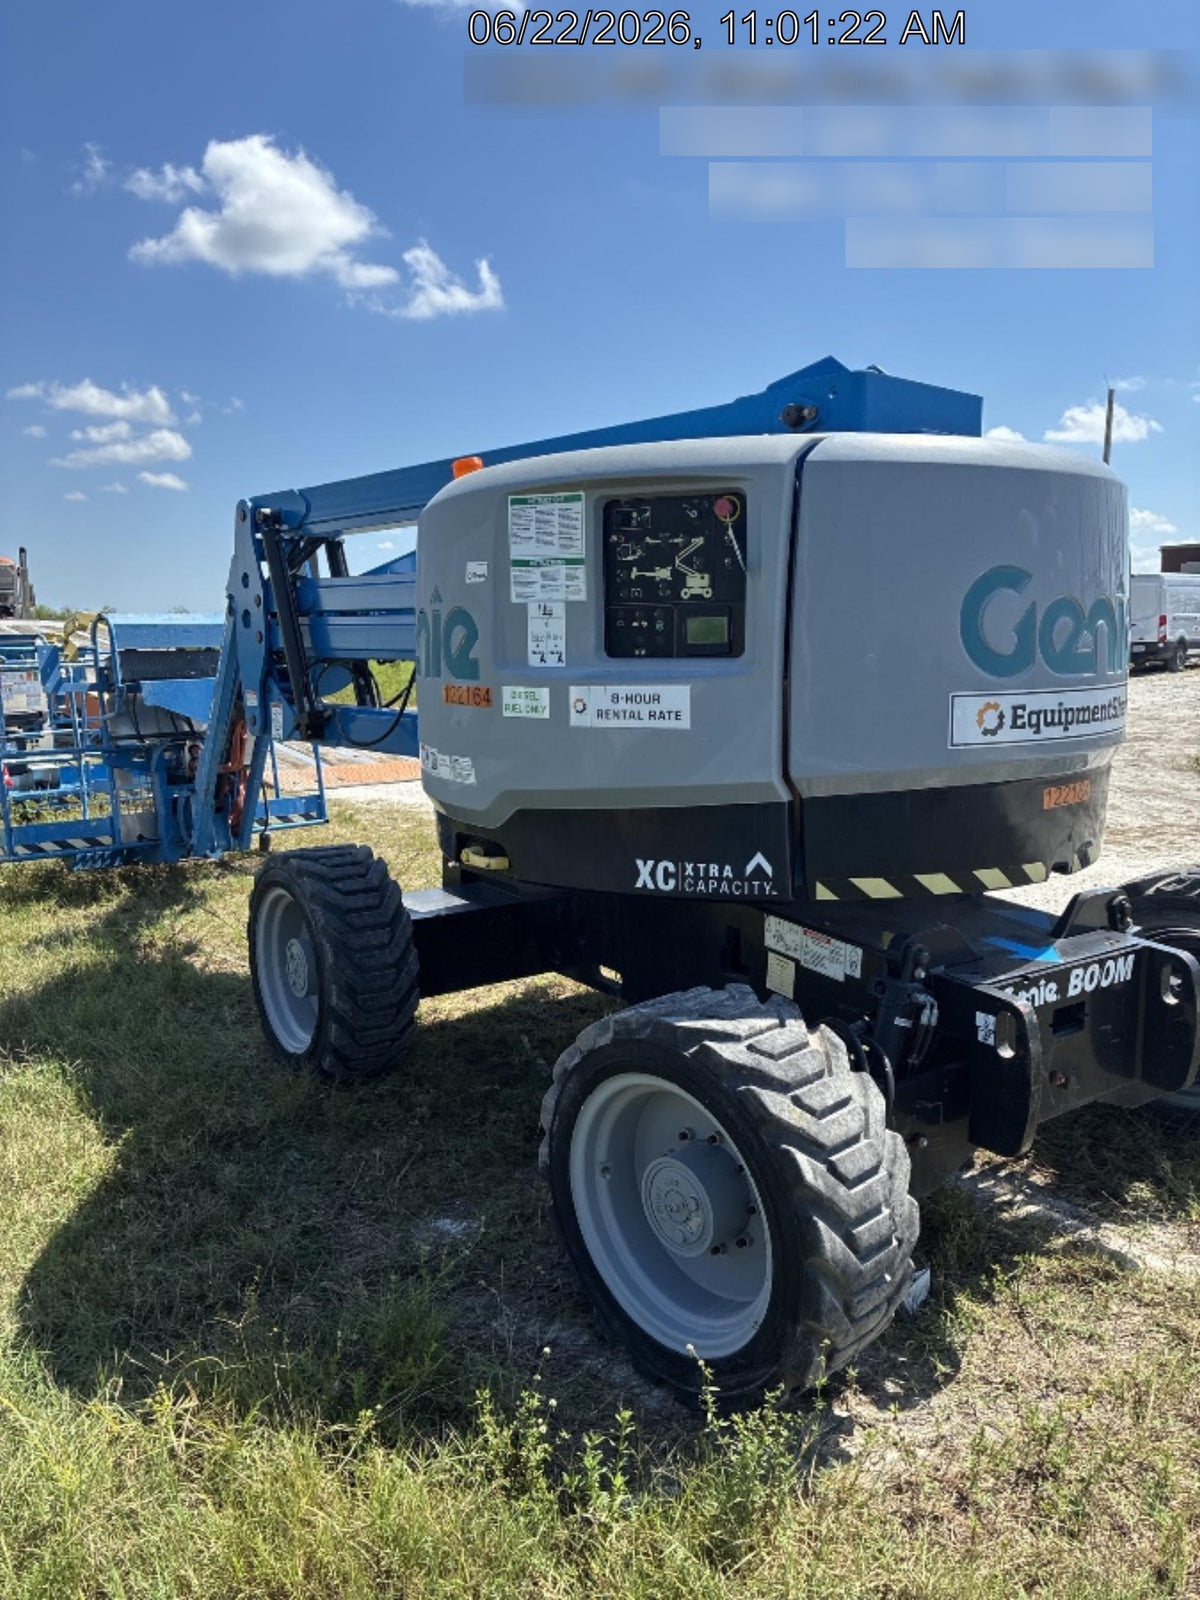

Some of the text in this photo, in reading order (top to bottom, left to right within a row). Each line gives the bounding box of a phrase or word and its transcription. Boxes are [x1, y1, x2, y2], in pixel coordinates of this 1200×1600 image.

[960, 564, 1128, 679] Geni
[444, 685, 492, 708] 122164
[610, 693, 661, 705] 8-HOUR
[525, 704, 547, 715] ONLY
[596, 709, 682, 721] RENTAL RATE
[634, 858, 734, 891] XC XTRA
[684, 877, 774, 896] CAPACITY
[1067, 953, 1136, 998] BOOM
